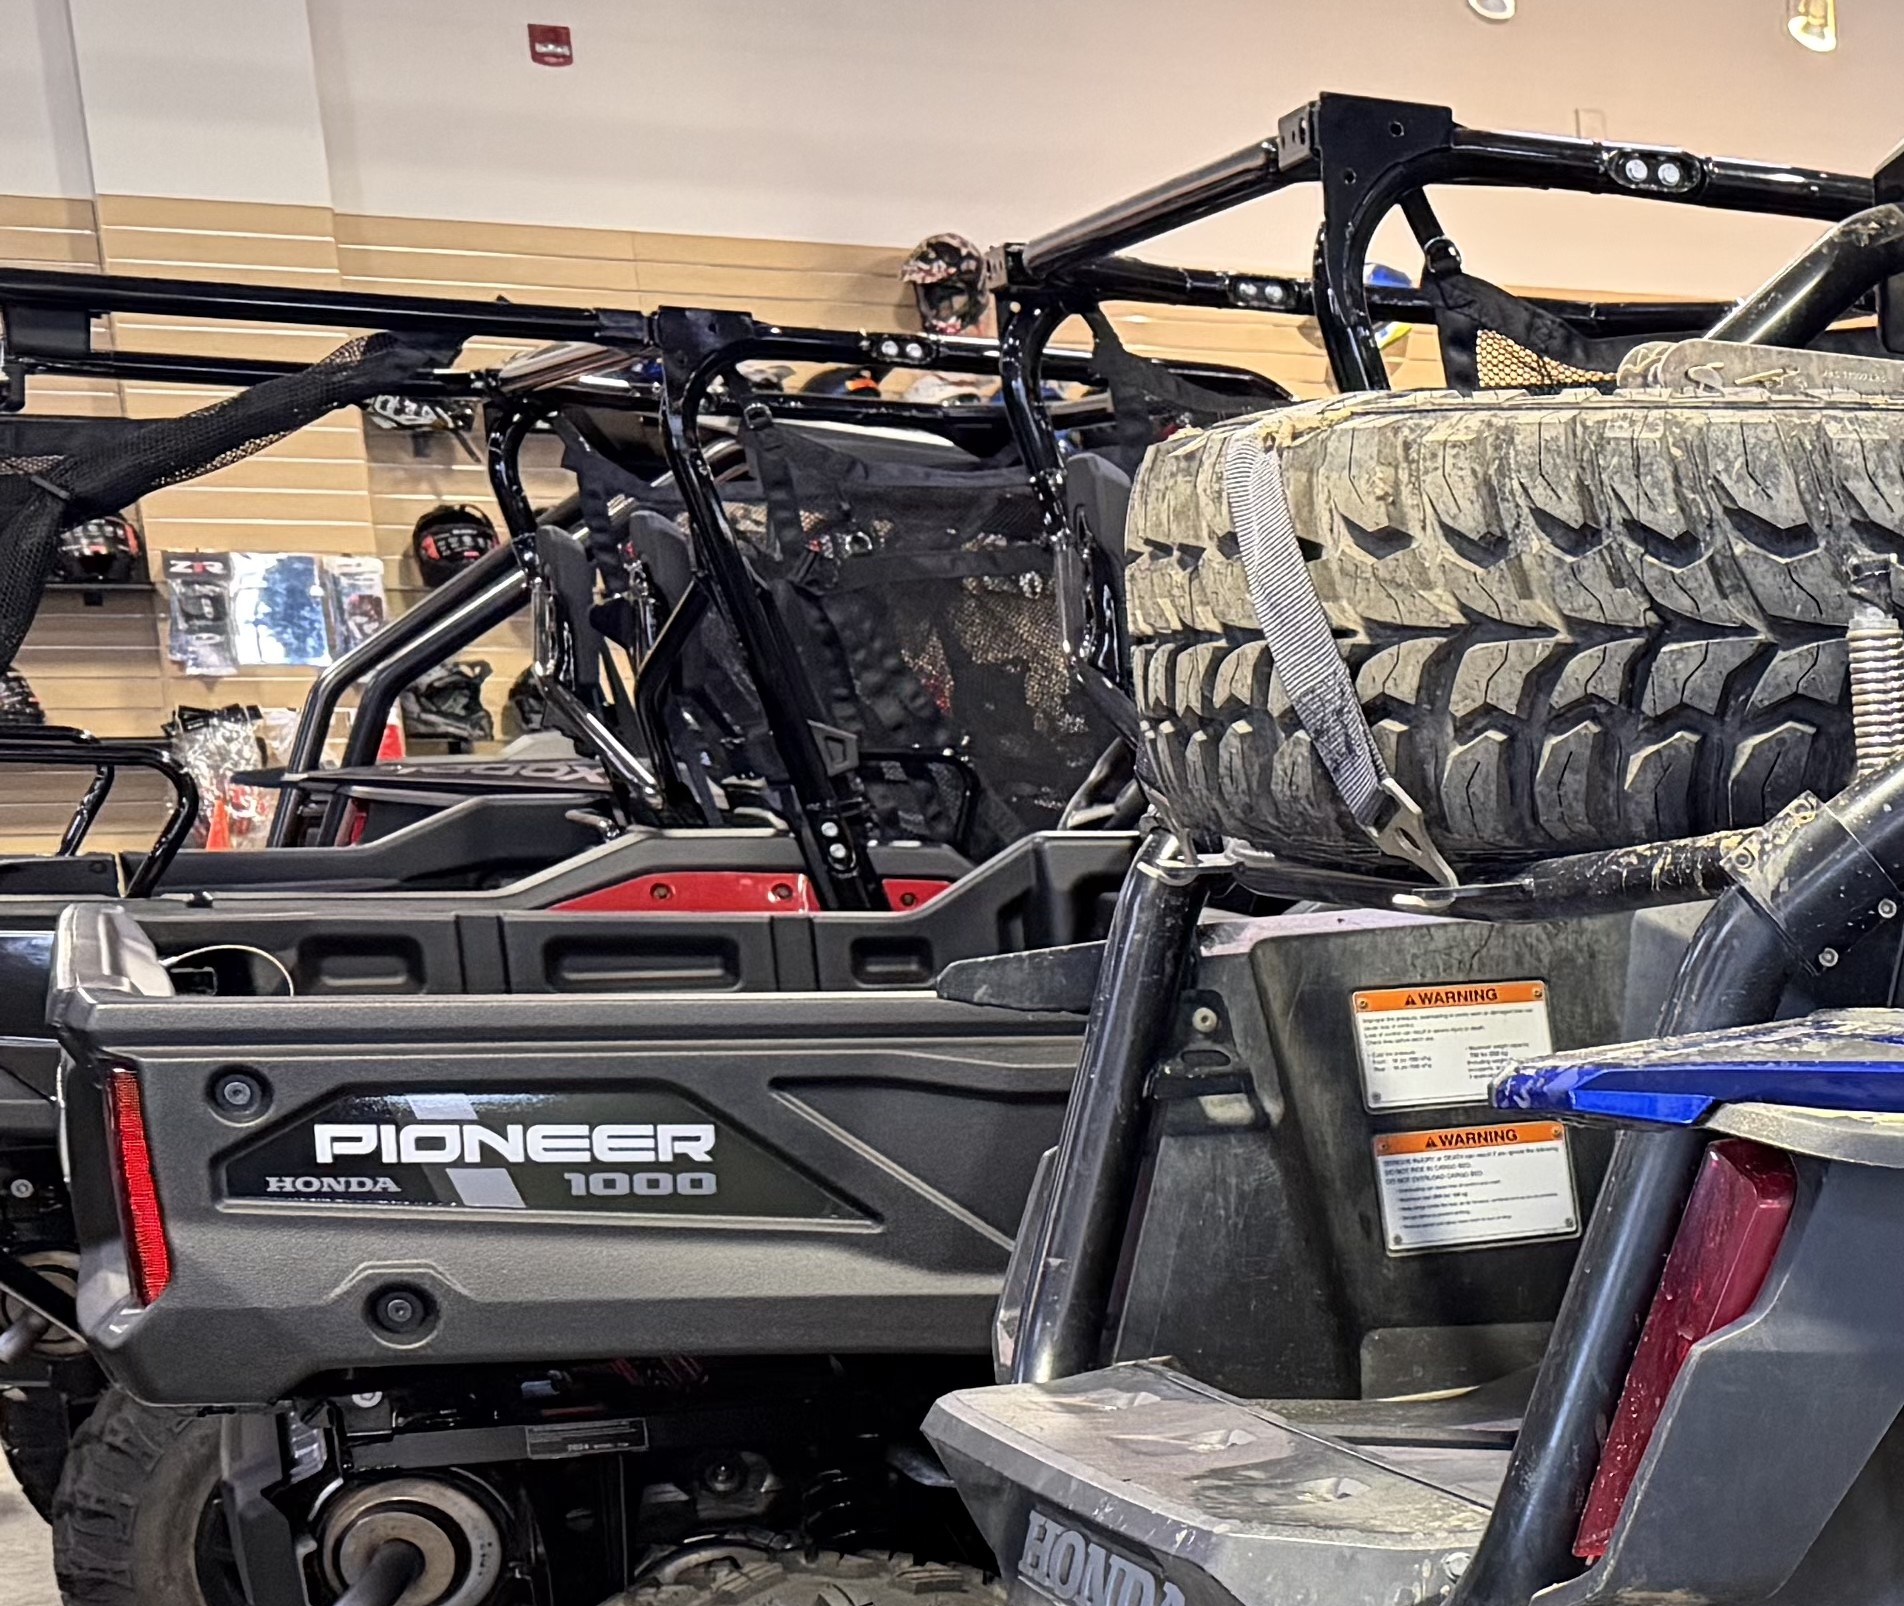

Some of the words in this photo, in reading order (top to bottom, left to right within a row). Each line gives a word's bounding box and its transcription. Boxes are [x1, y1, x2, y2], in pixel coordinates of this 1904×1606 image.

[1418, 988, 1498, 1006] WARNING
[313, 1123, 717, 1163] PIONEER
[1438, 1128, 1518, 1147] WARNING
[265, 1176, 402, 1193] HONDA
[562, 1172, 718, 1196] 1000
